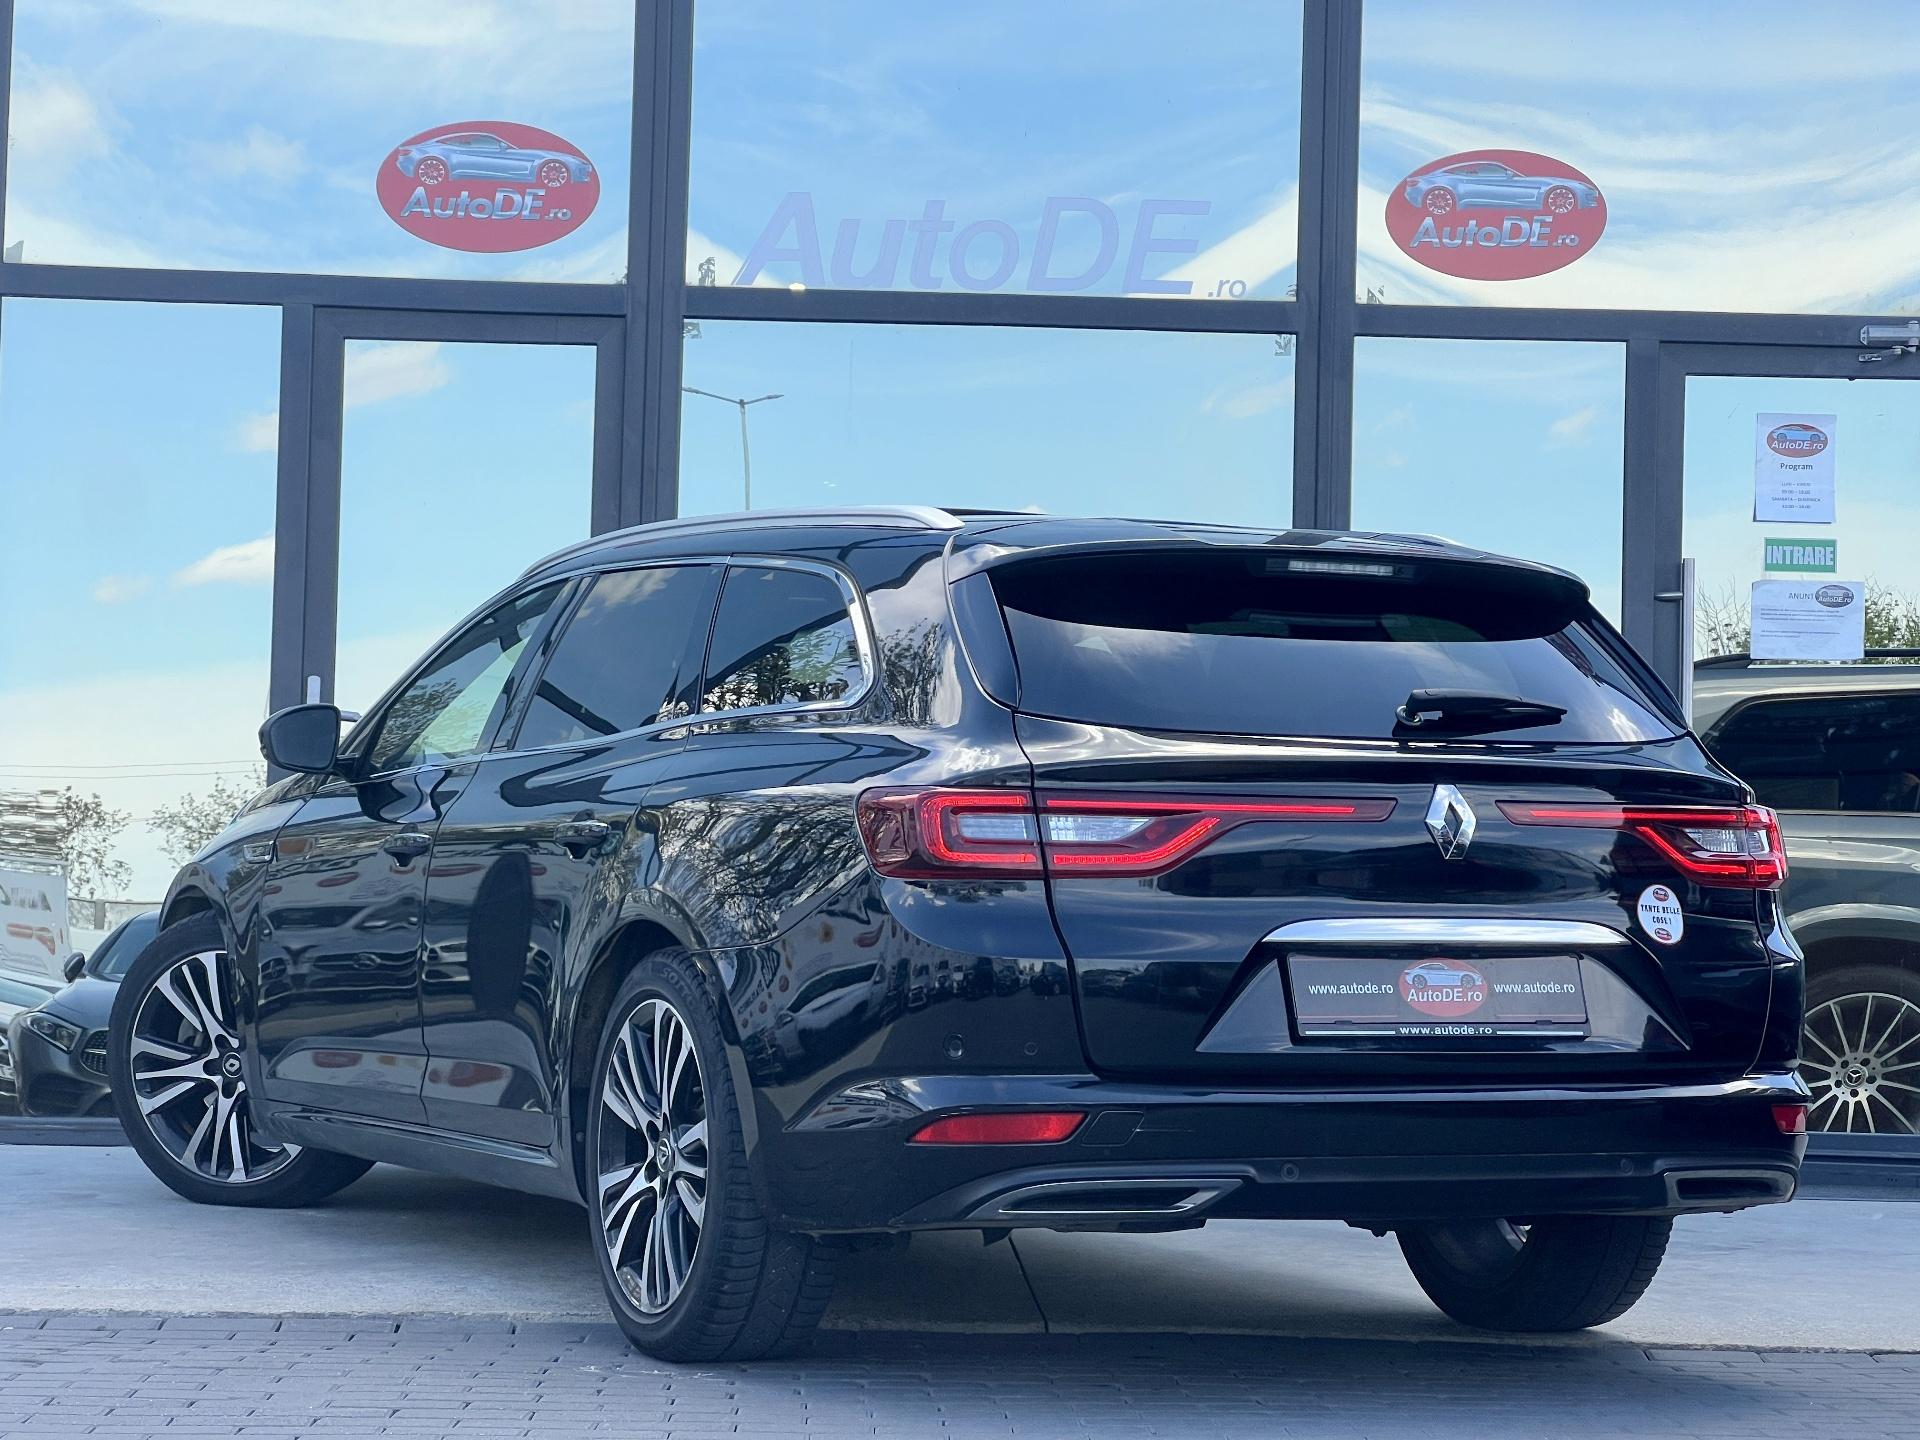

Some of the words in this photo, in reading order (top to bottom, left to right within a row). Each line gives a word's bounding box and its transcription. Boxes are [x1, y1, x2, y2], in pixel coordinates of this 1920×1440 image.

[1771, 440, 1824, 450] AutoDE.ro
[1780, 462, 1813, 471] Program
[1766, 545, 1834, 566] INTRARE
[1641, 904, 1660, 913] TANTE
[1662, 906, 1680, 915] BELLE
[1308, 982, 1394, 994] www.autode.ro
[1407, 988, 1483, 1002] AutoDE.ro
[1494, 982, 1575, 994] www.autode.ro
[1400, 1024, 1493, 1035] www.autode.ro
